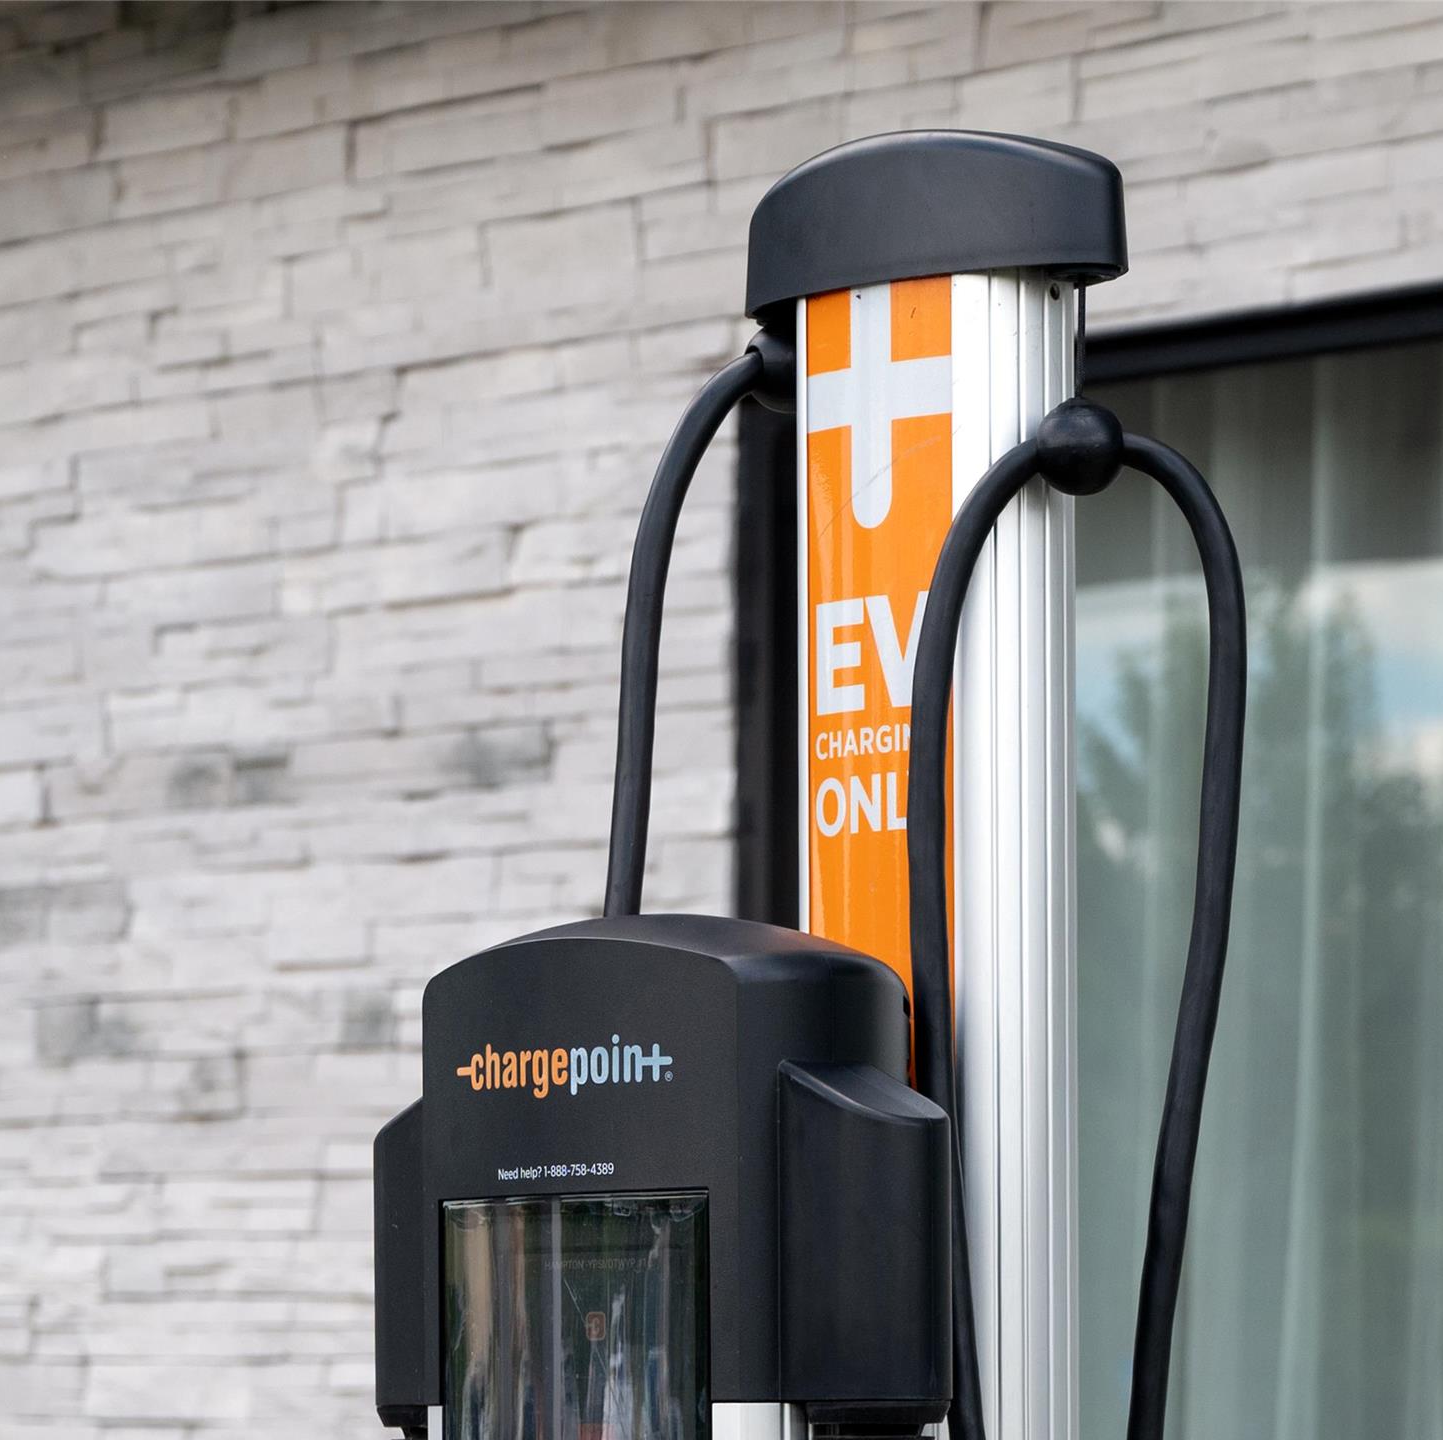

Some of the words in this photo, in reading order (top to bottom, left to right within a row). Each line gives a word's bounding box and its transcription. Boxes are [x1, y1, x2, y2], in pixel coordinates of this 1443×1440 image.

[815, 590, 930, 716] EV
[815, 724, 911, 761] CHARGI
[815, 771, 909, 838] ONL
[497, 1167, 518, 1180] Need
[520, 1165, 542, 1180] help?
[544, 1162, 614, 1177] 1-888-758-4389
